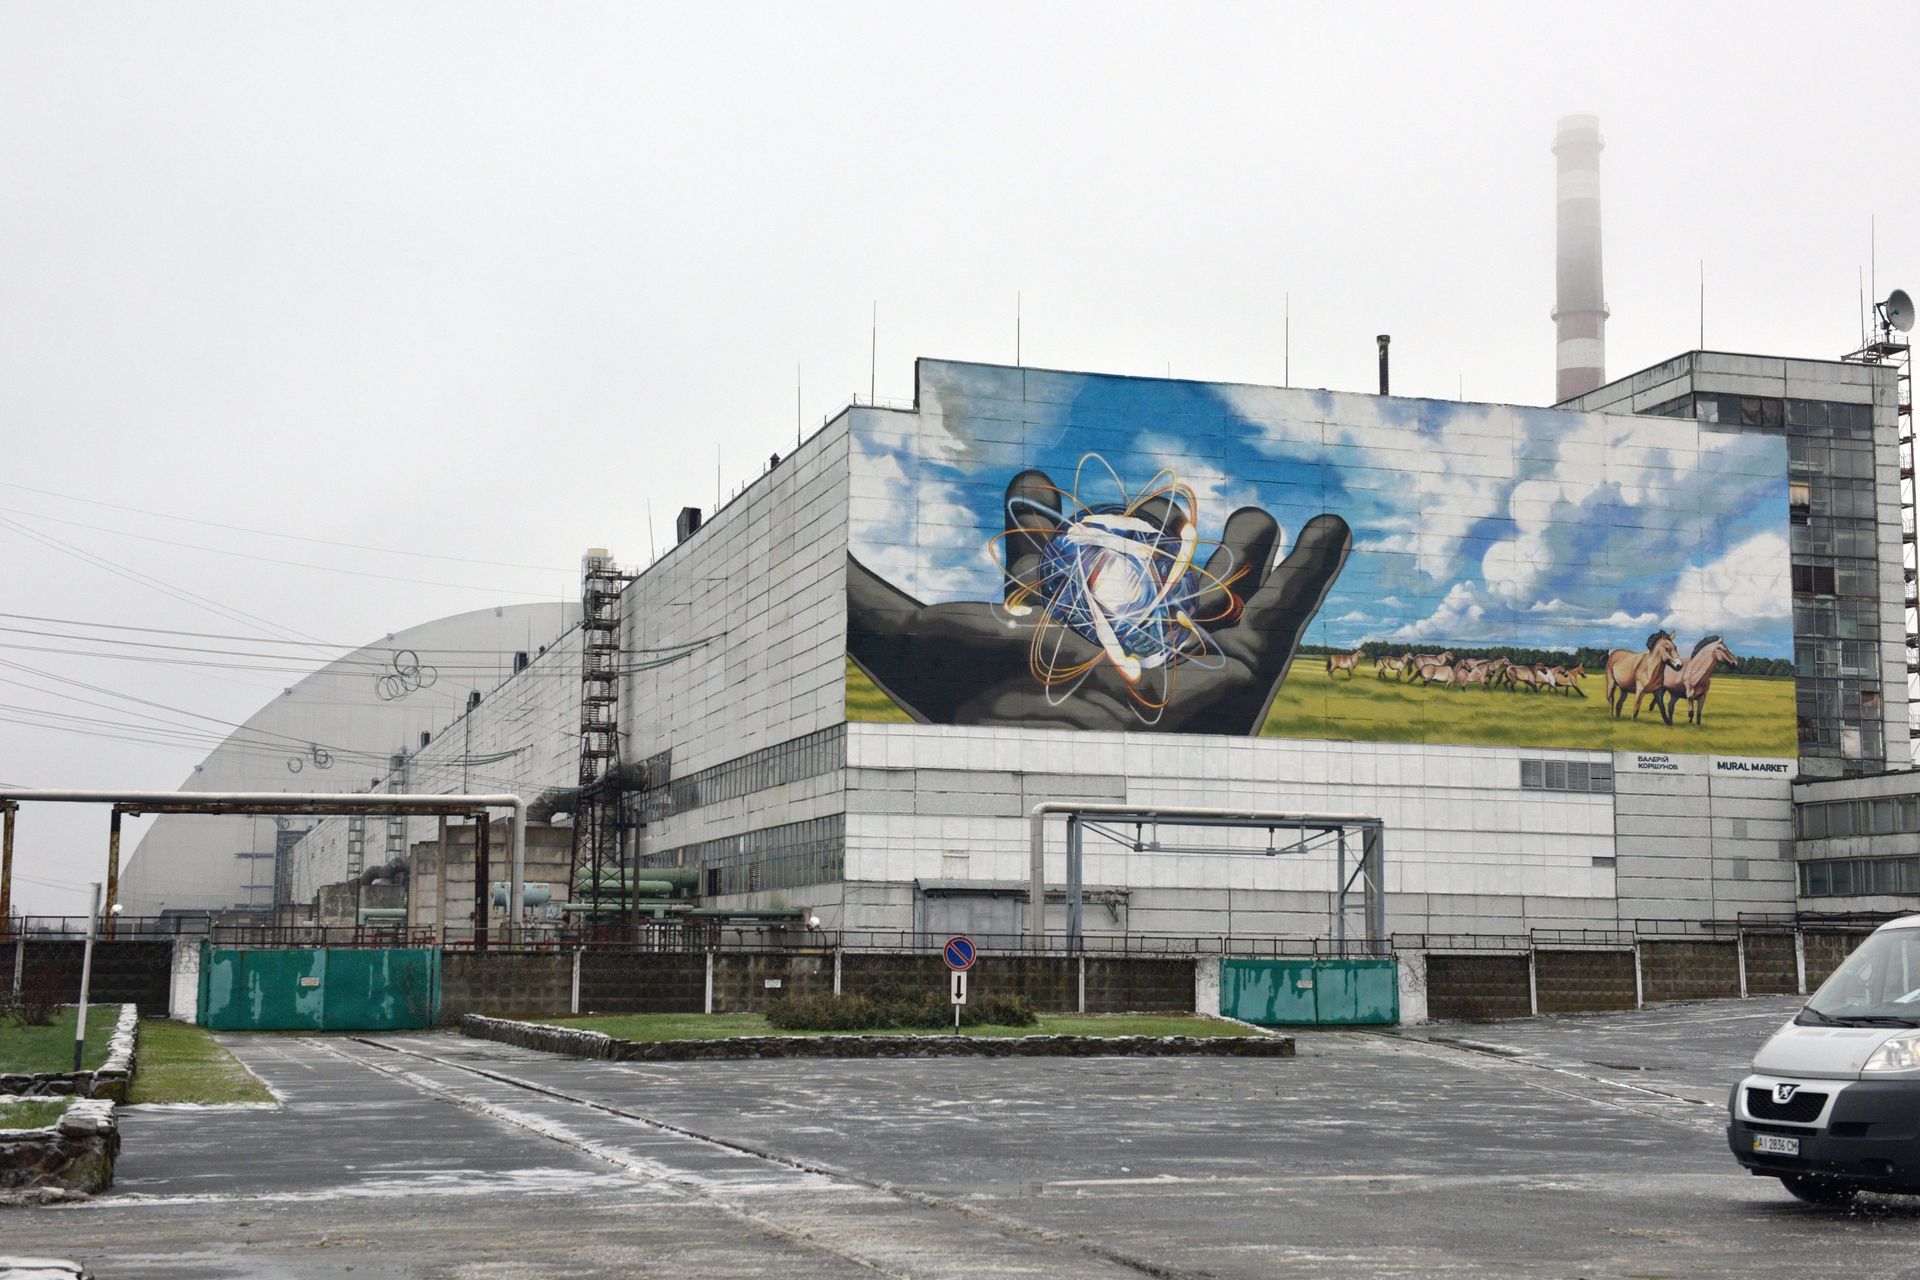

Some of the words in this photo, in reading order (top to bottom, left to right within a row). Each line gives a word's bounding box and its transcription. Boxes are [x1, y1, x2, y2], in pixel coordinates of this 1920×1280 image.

[1717, 761, 1749, 771] MURAL
[1751, 763, 1788, 773] MARKET
[1769, 1138, 1785, 1151] 2836
